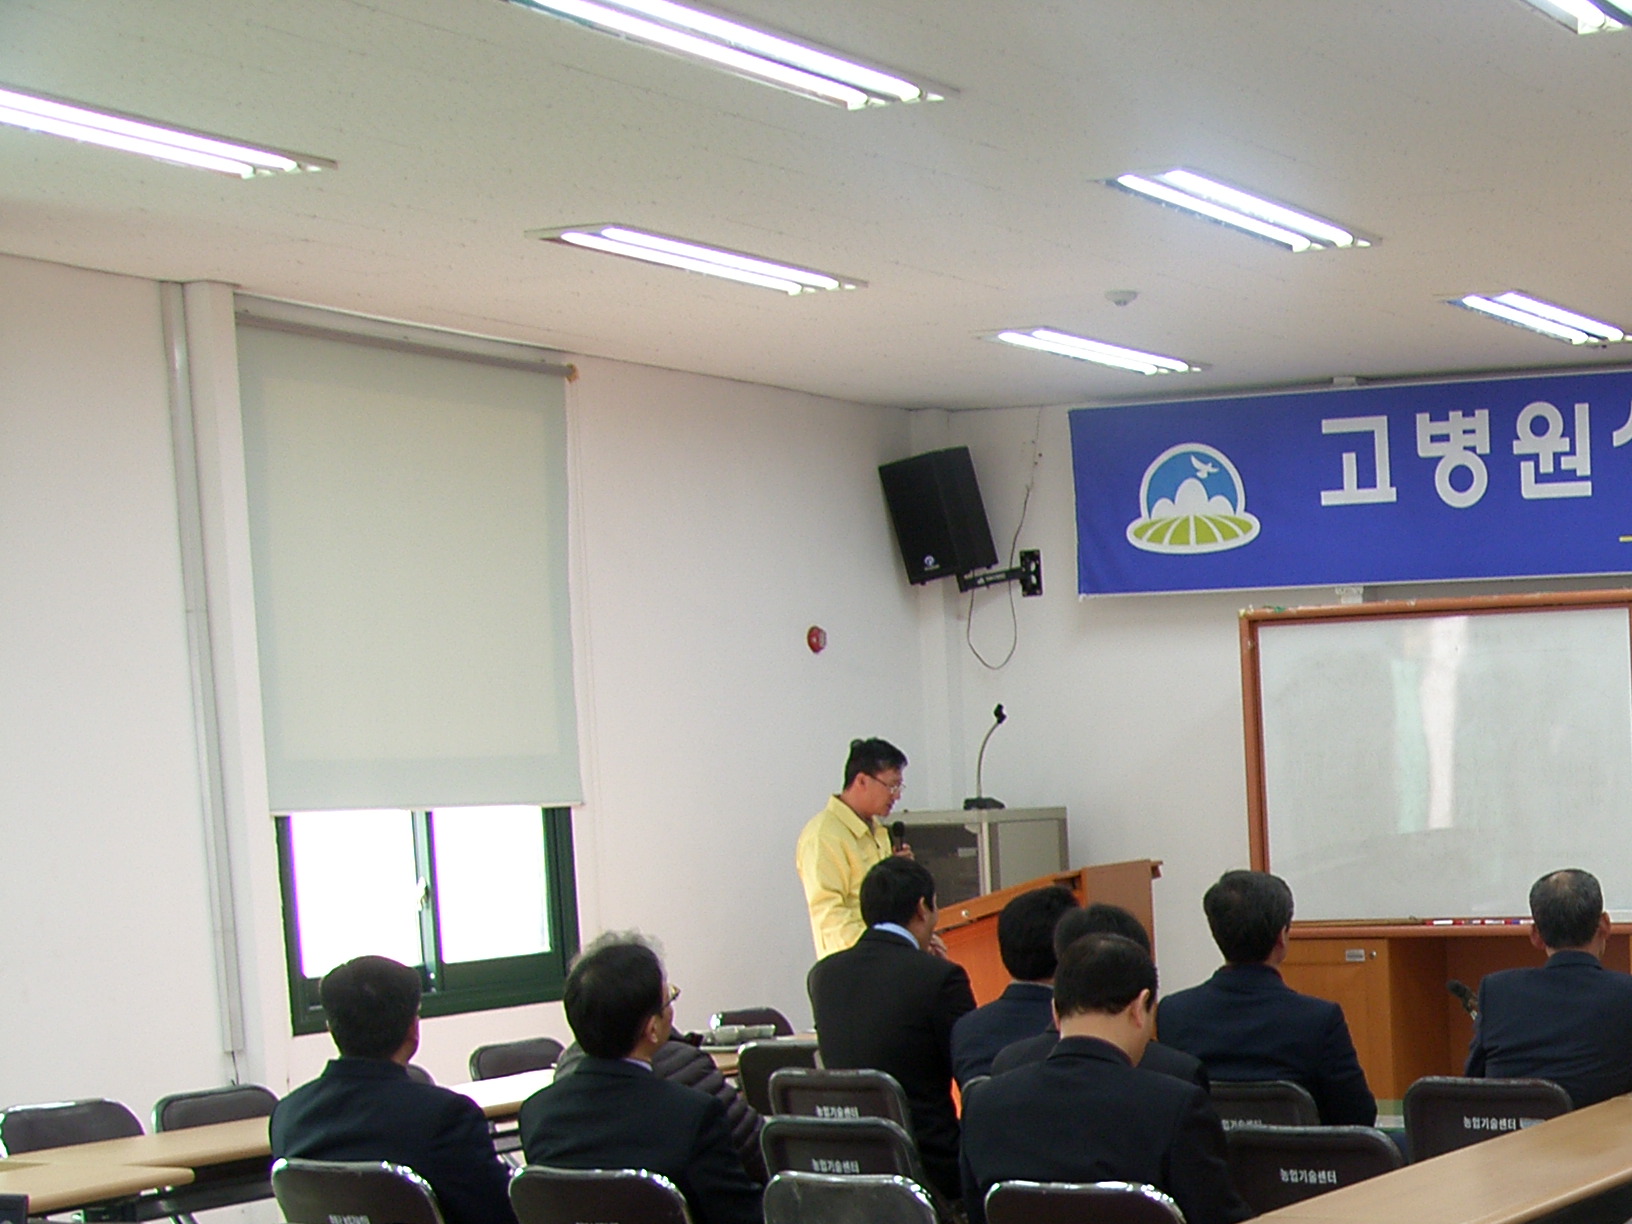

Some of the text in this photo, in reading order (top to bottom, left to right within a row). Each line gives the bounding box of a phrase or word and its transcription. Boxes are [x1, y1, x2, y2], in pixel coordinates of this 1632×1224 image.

[1462, 1115, 1517, 1131] 농업기술센터
[811, 1158, 860, 1174] 농업기술센터
[1279, 1167, 1338, 1185] 농업기술센터
